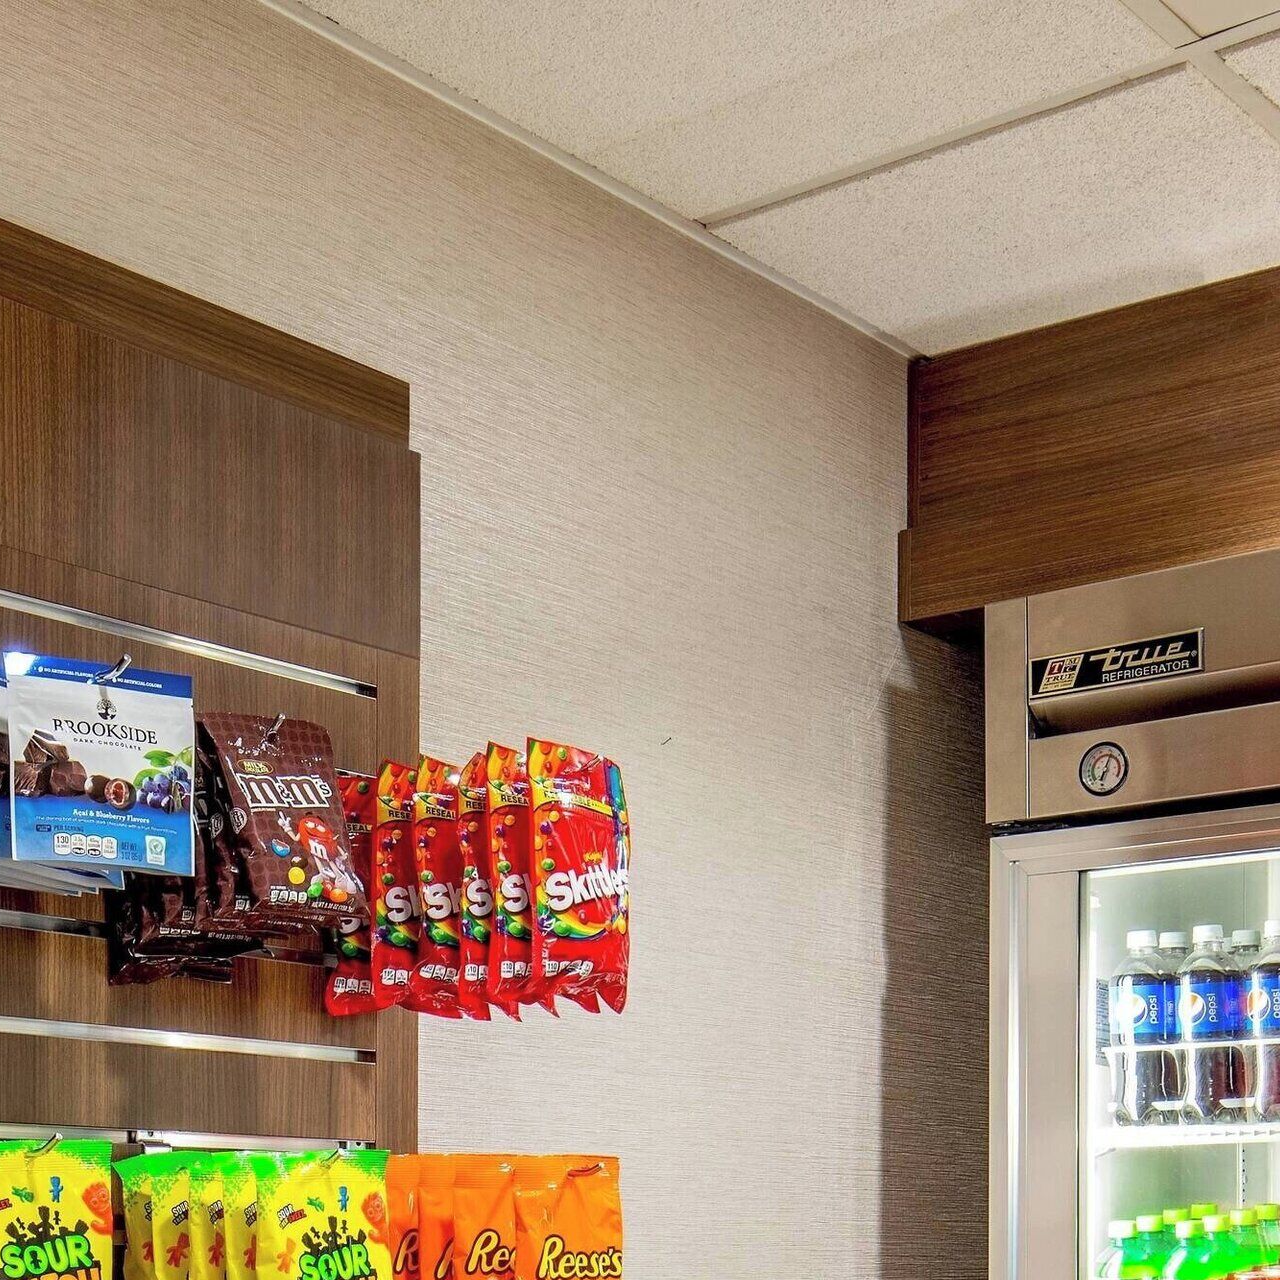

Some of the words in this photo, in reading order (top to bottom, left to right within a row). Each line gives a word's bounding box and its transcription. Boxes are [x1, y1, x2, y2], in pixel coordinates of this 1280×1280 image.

[1102, 660, 1190, 682] REFRIGERATOR
[52, 718, 158, 745] BROOKSIDE
[98, 740, 142, 751] CHOCOLATE
[1149, 996, 1159, 1024] pepsi
[1, 1235, 92, 1278] SOUR
[537, 1235, 623, 1280] Reese's
